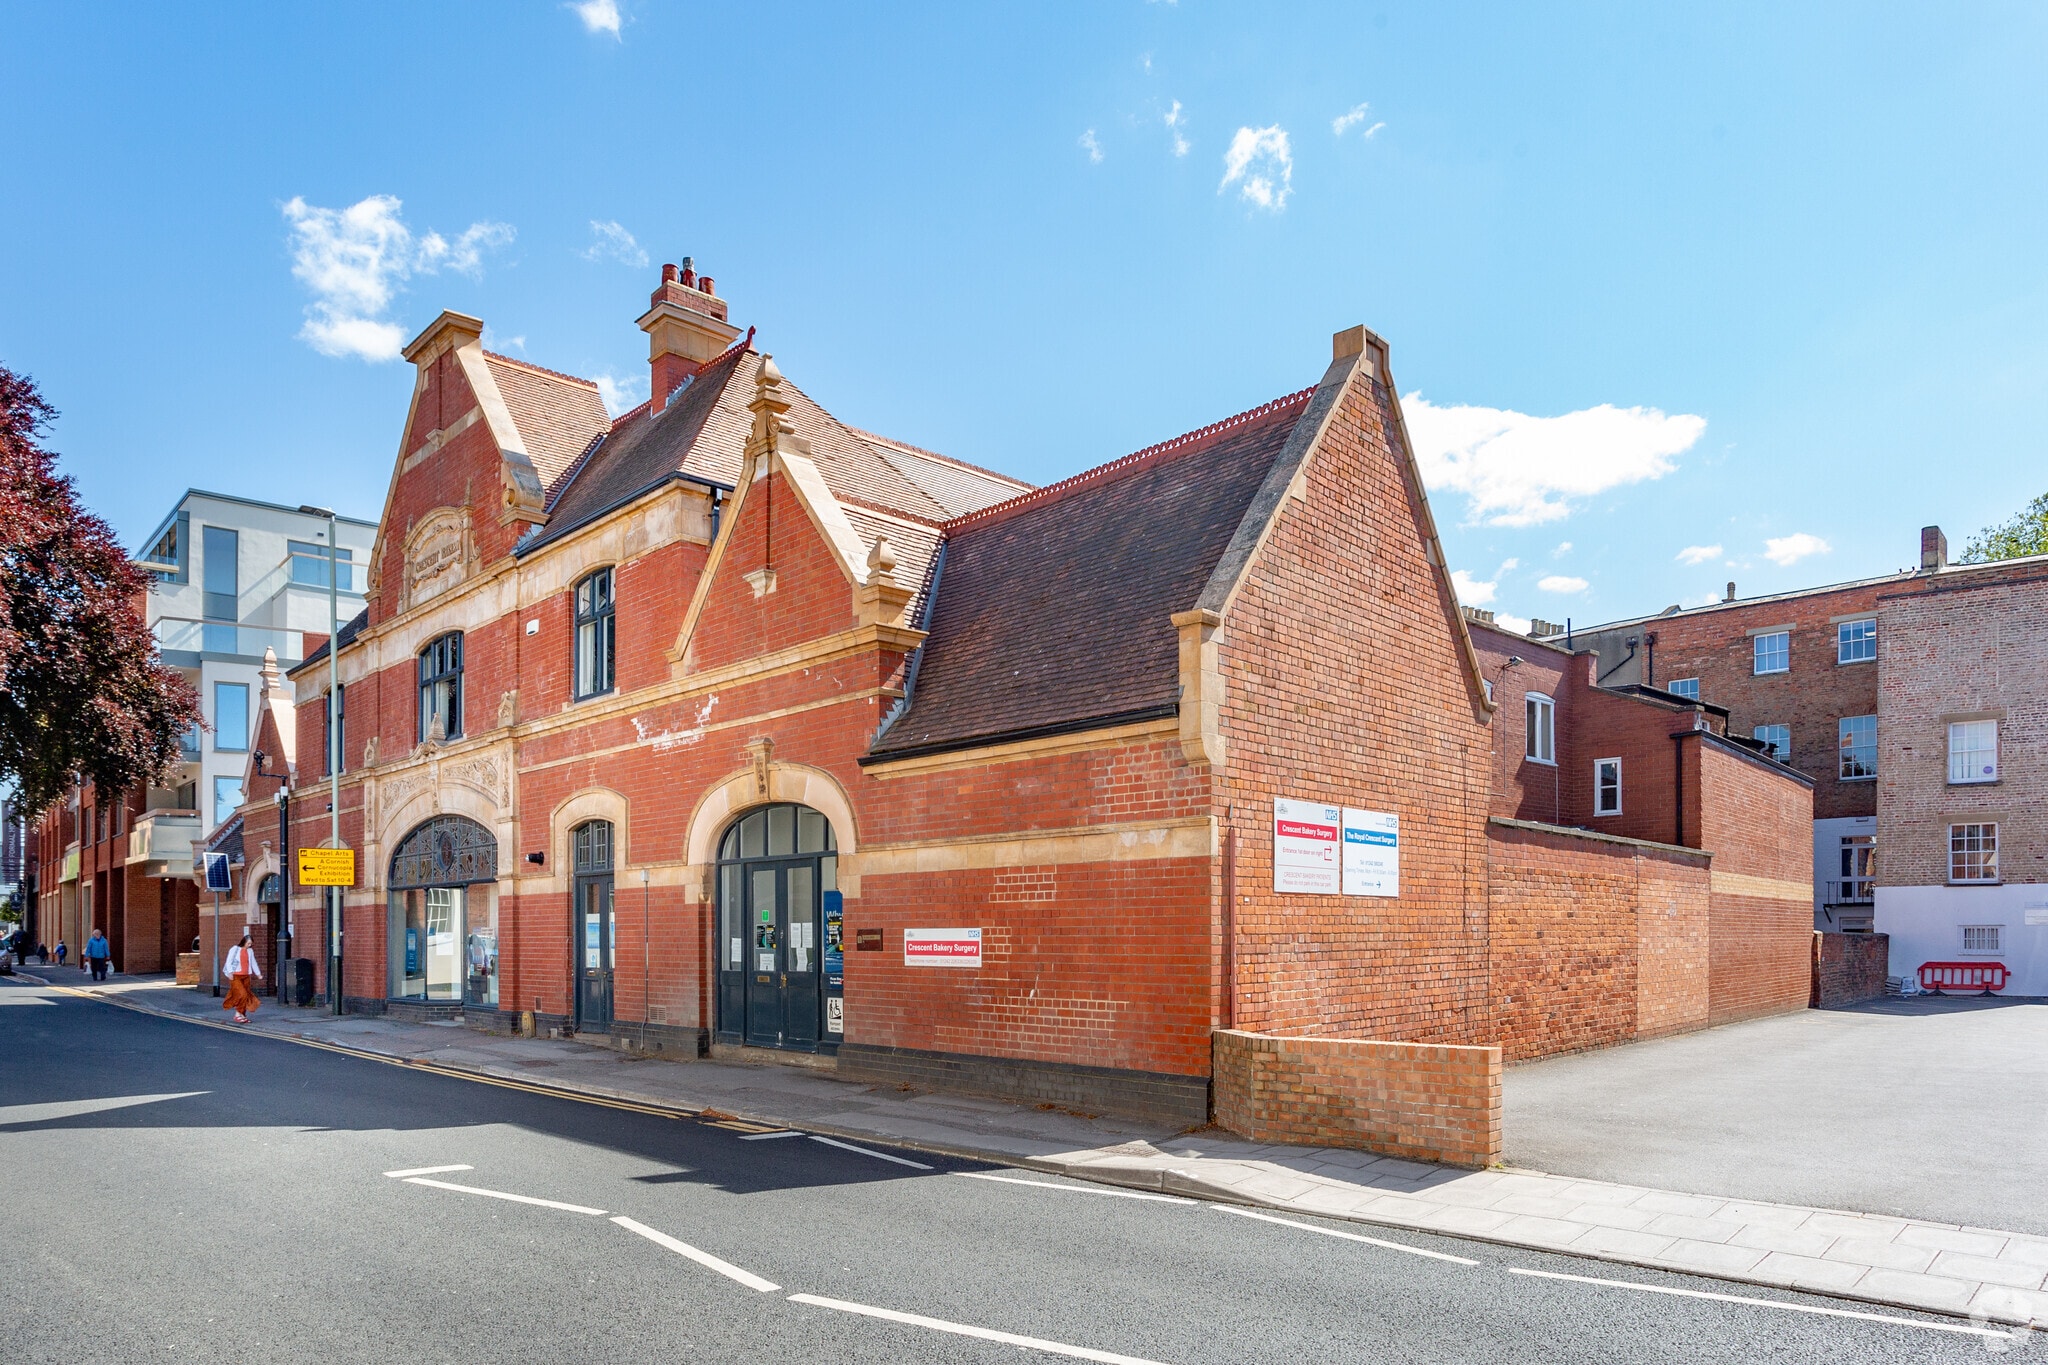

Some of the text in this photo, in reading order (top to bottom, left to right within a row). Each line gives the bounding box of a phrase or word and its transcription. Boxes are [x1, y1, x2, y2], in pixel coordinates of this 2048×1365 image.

[1326, 810, 1337, 820] NHS
[1386, 817, 1397, 828] NHS
[1282, 824, 1333, 839] Crescent Bakery Surgery
[1346, 831, 1395, 846] The Royal Crescent Surgery
[908, 943, 978, 954] Crescent Bakery Surgery
